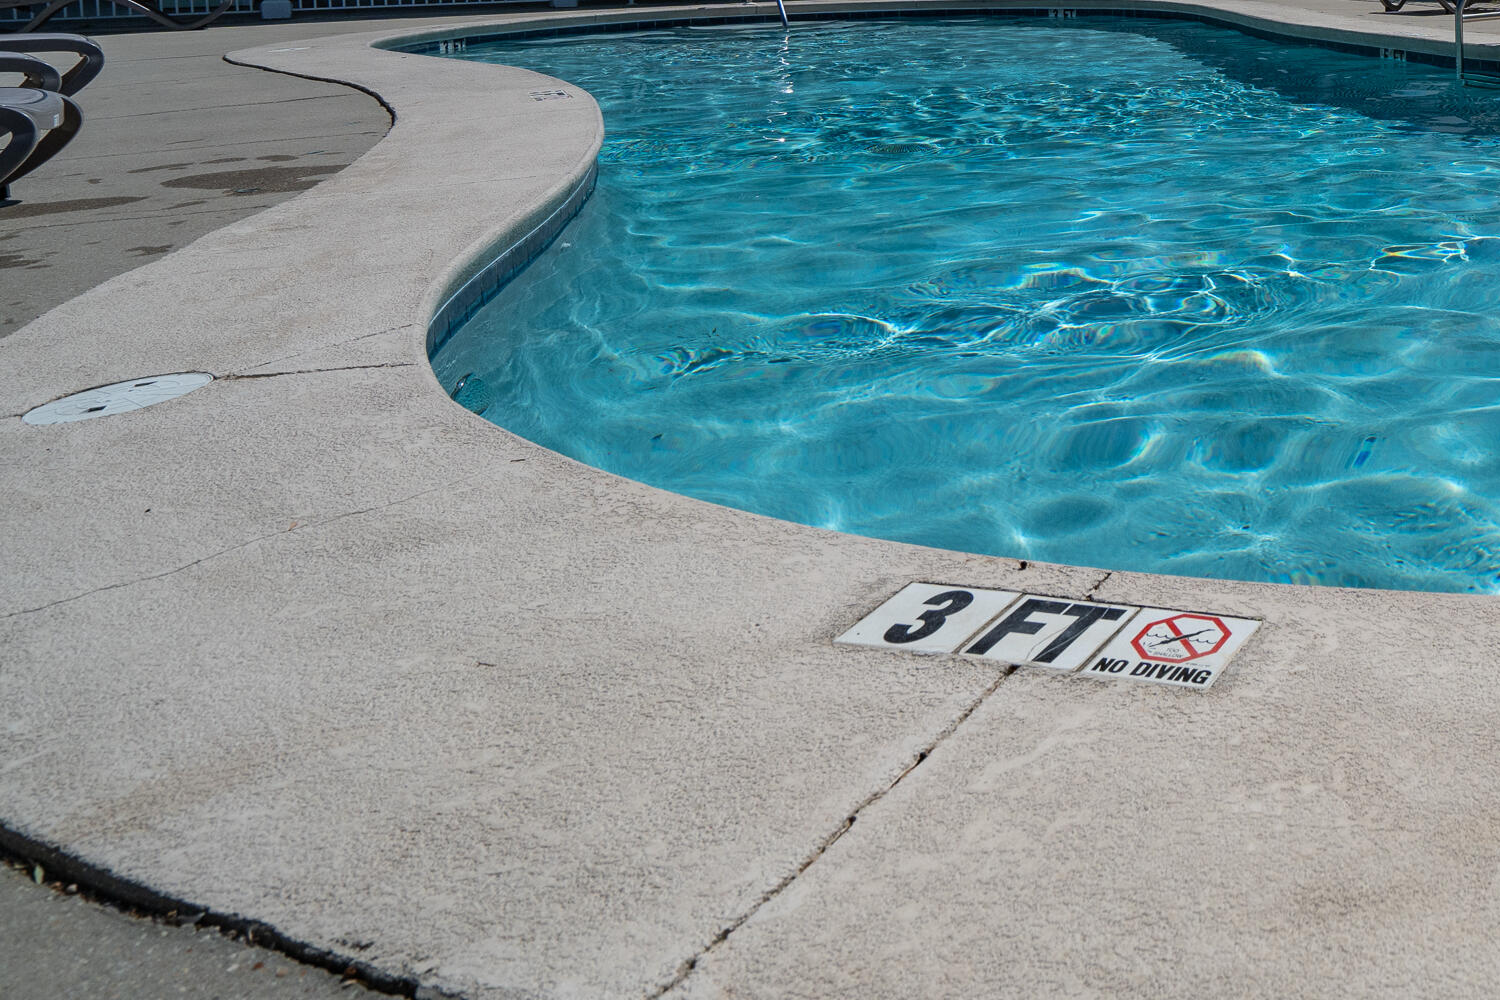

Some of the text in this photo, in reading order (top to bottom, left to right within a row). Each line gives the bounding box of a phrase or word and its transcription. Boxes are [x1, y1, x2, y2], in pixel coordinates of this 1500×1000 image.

[883, 590, 1128, 664] 3 FT
[1092, 656, 1212, 685] NO DIVING
